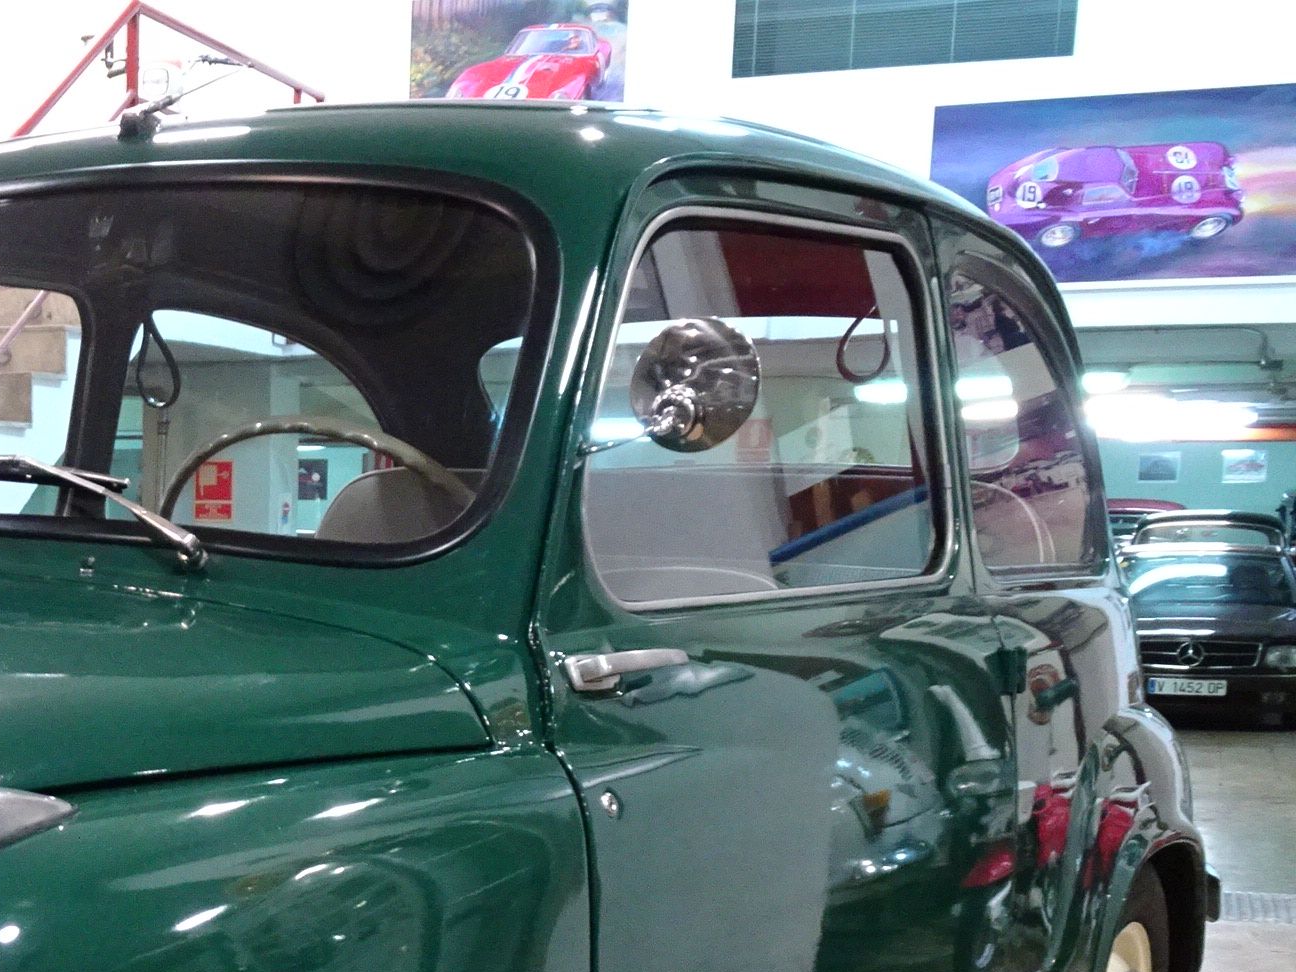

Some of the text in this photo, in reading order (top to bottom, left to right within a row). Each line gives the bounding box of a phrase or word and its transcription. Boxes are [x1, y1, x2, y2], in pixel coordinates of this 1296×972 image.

[1022, 183, 1037, 202] 19
[1157, 681, 1165, 693] V
[1172, 681, 1203, 694] 1452
